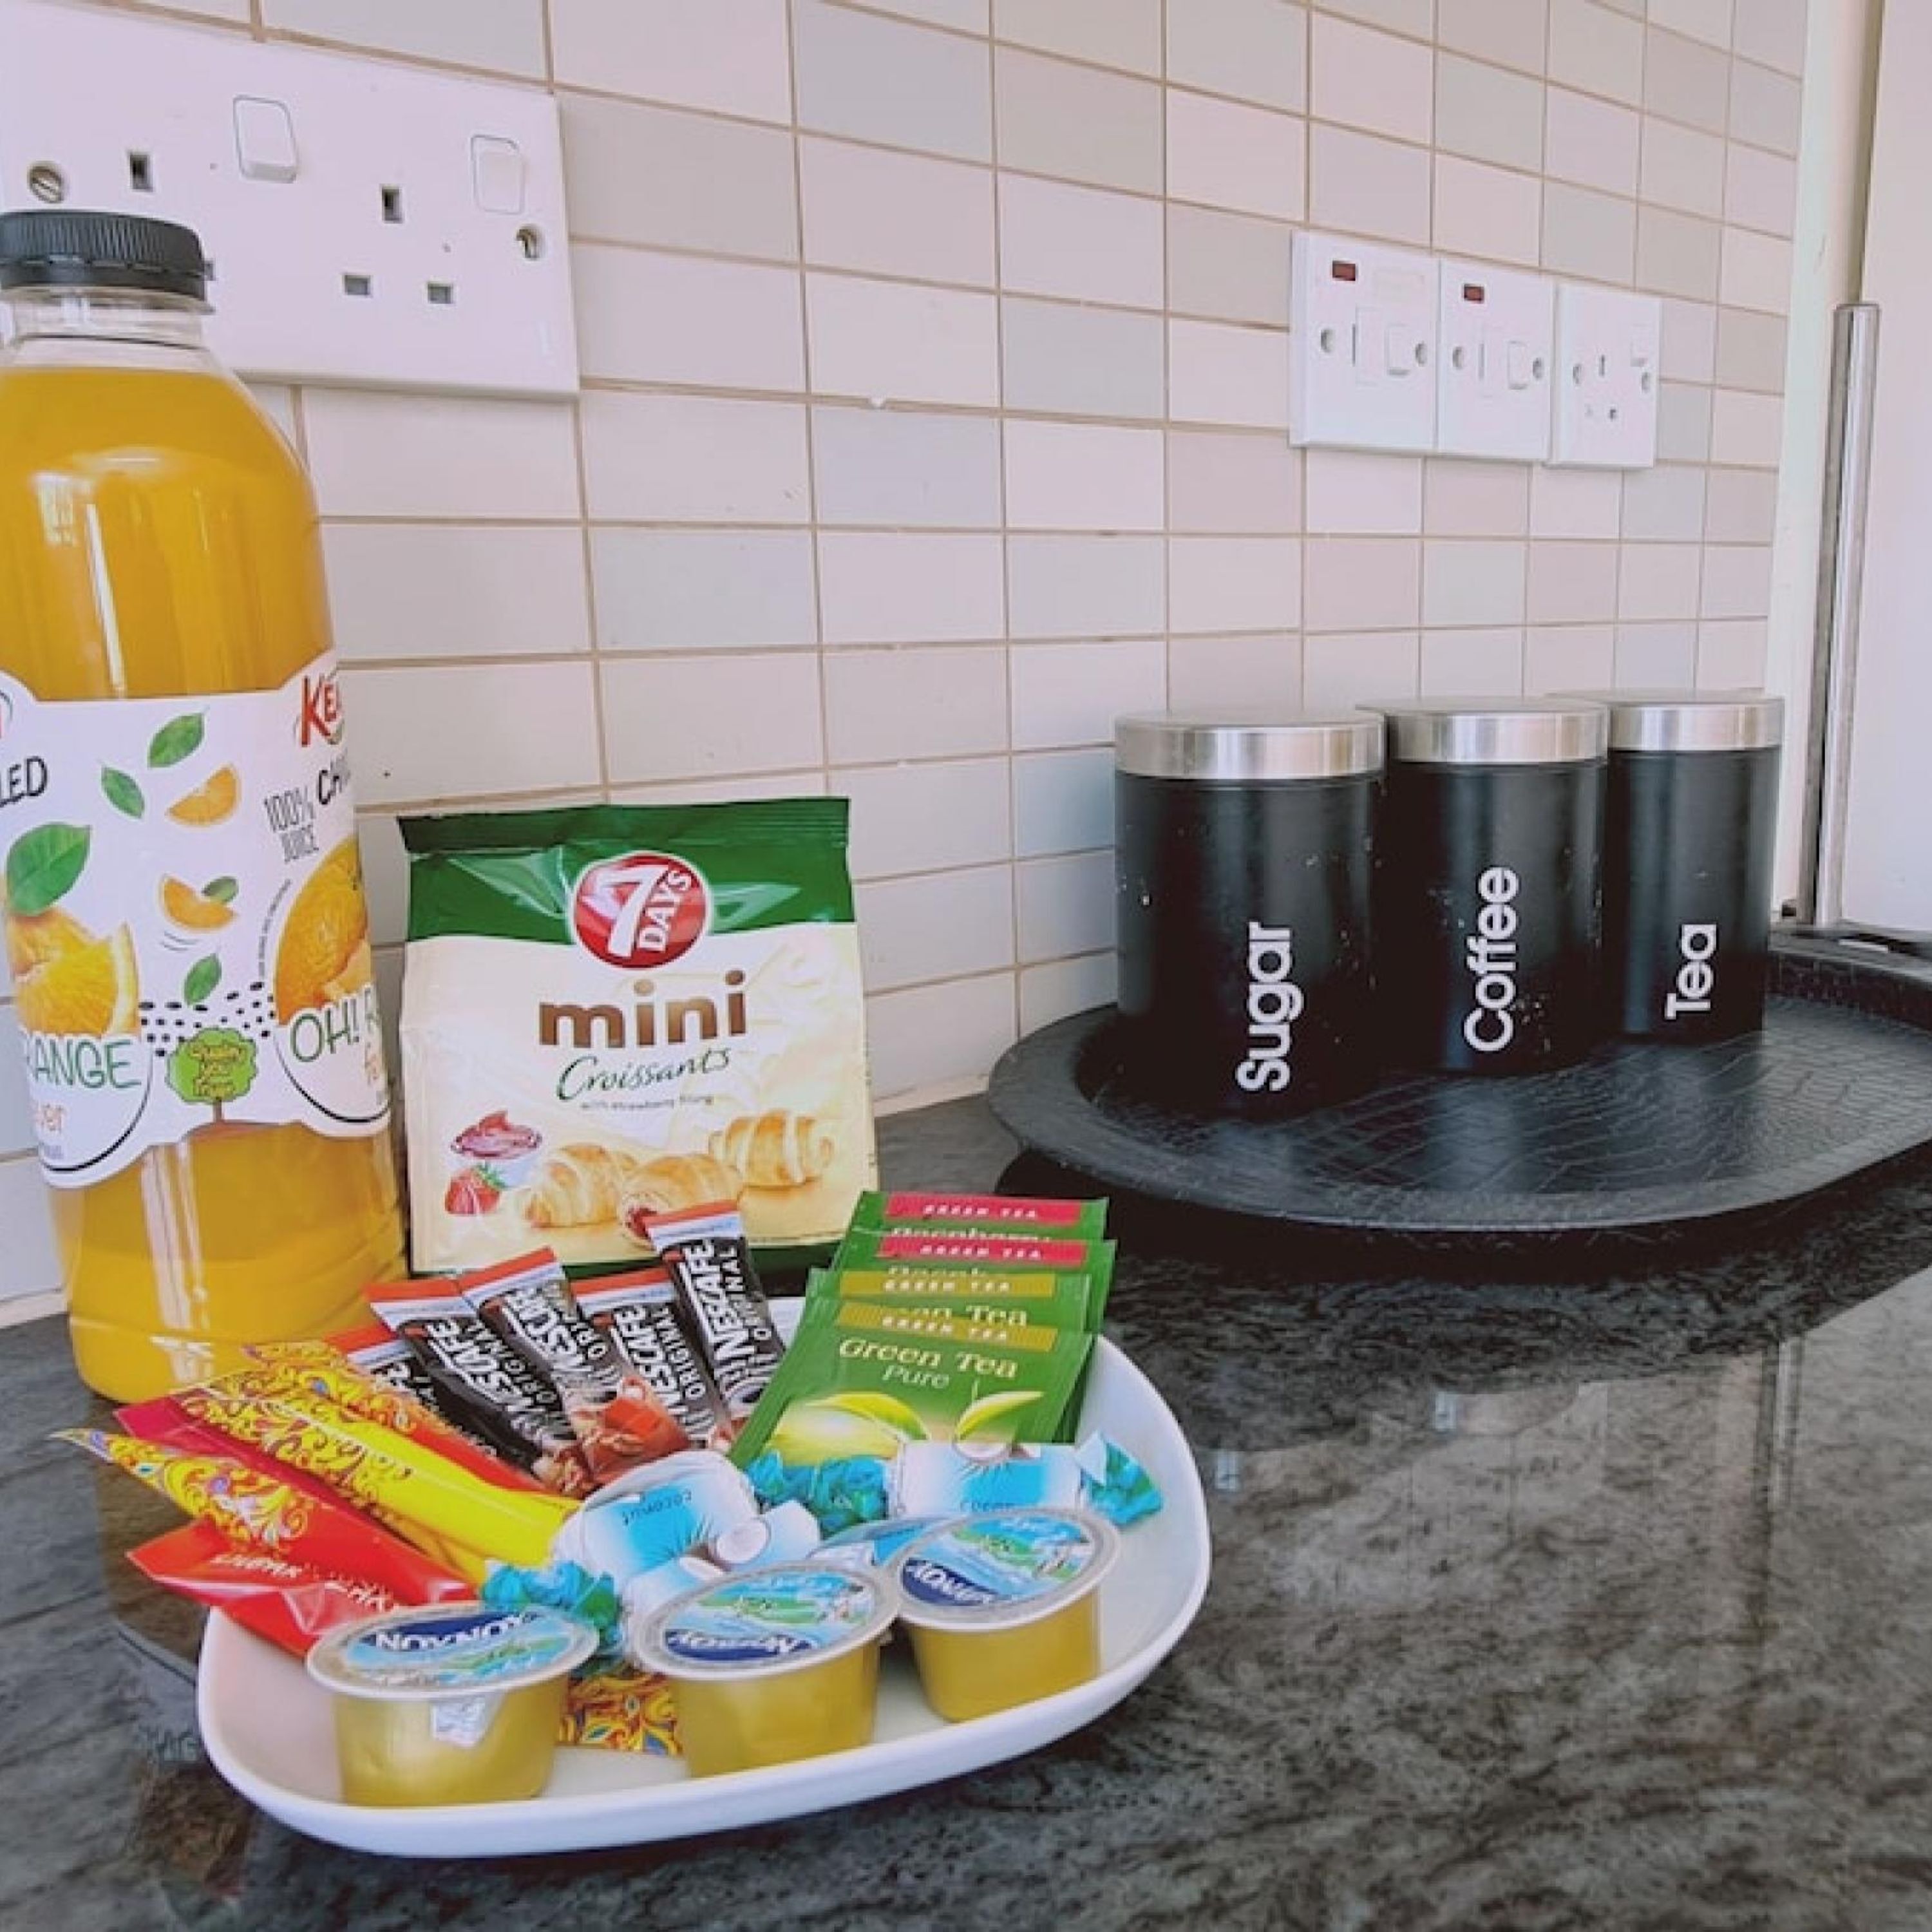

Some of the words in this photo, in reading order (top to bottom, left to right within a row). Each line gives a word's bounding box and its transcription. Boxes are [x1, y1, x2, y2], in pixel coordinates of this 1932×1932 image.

[582, 865, 670, 958] 7
[638, 870, 696, 953] DAYS
[1463, 866, 1520, 1052] Coffee
[1665, 923, 1717, 1020] Tea
[538, 969, 746, 1048] mini
[1236, 922, 1304, 1092] Sugar
[556, 1047, 732, 1100] Croissants
[839, 1339, 942, 1367] Green
[956, 1353, 1019, 1379] Tea
